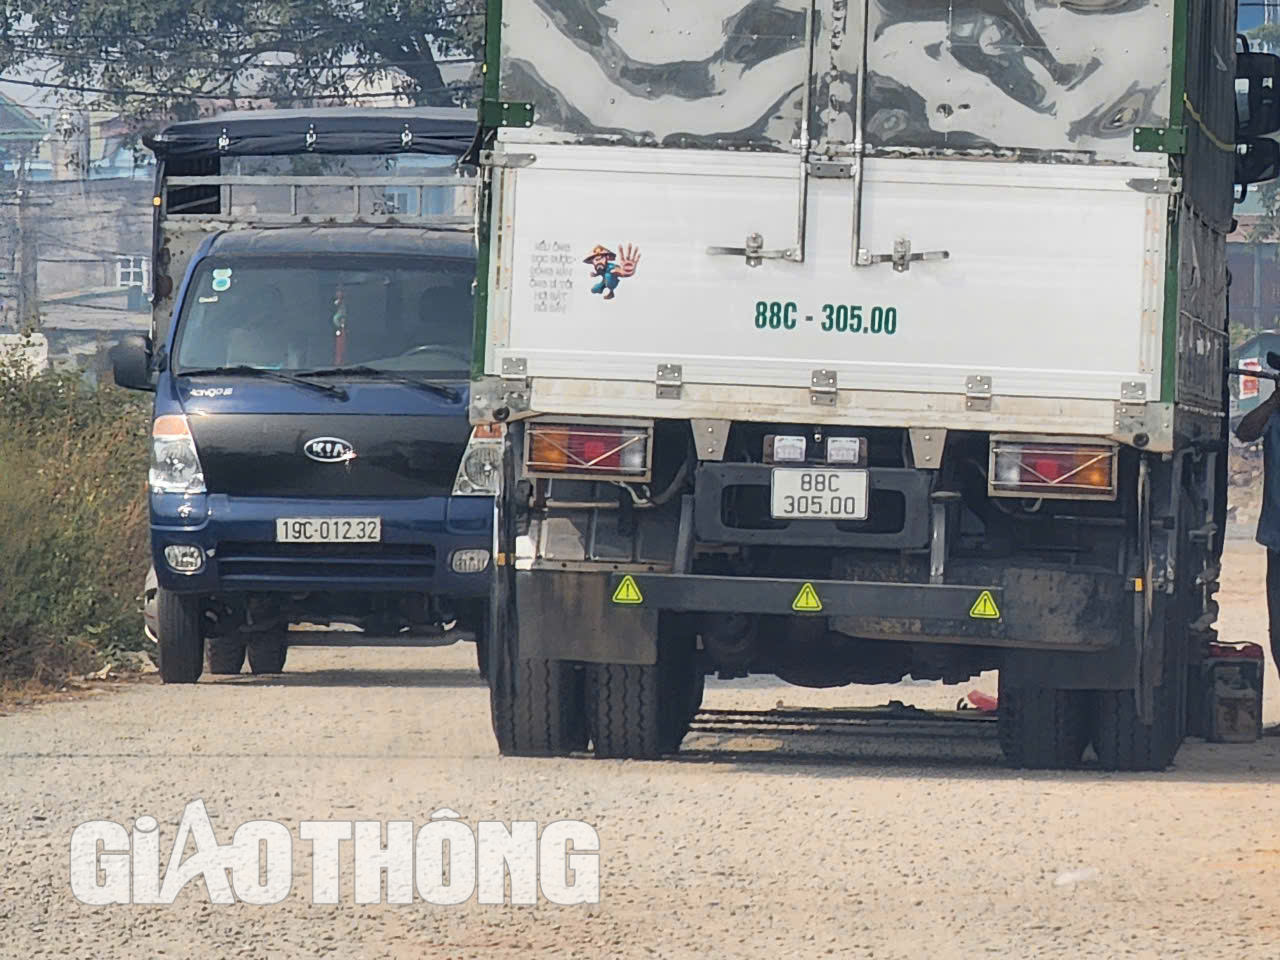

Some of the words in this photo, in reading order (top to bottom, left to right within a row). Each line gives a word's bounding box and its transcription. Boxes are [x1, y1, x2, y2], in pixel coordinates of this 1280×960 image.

[754, 300, 798, 330] 88C
[820, 303, 897, 335] 305.00
[312, 442, 346, 457] KIA
[801, 473, 840, 492] 88C
[783, 495, 856, 515] 305.00
